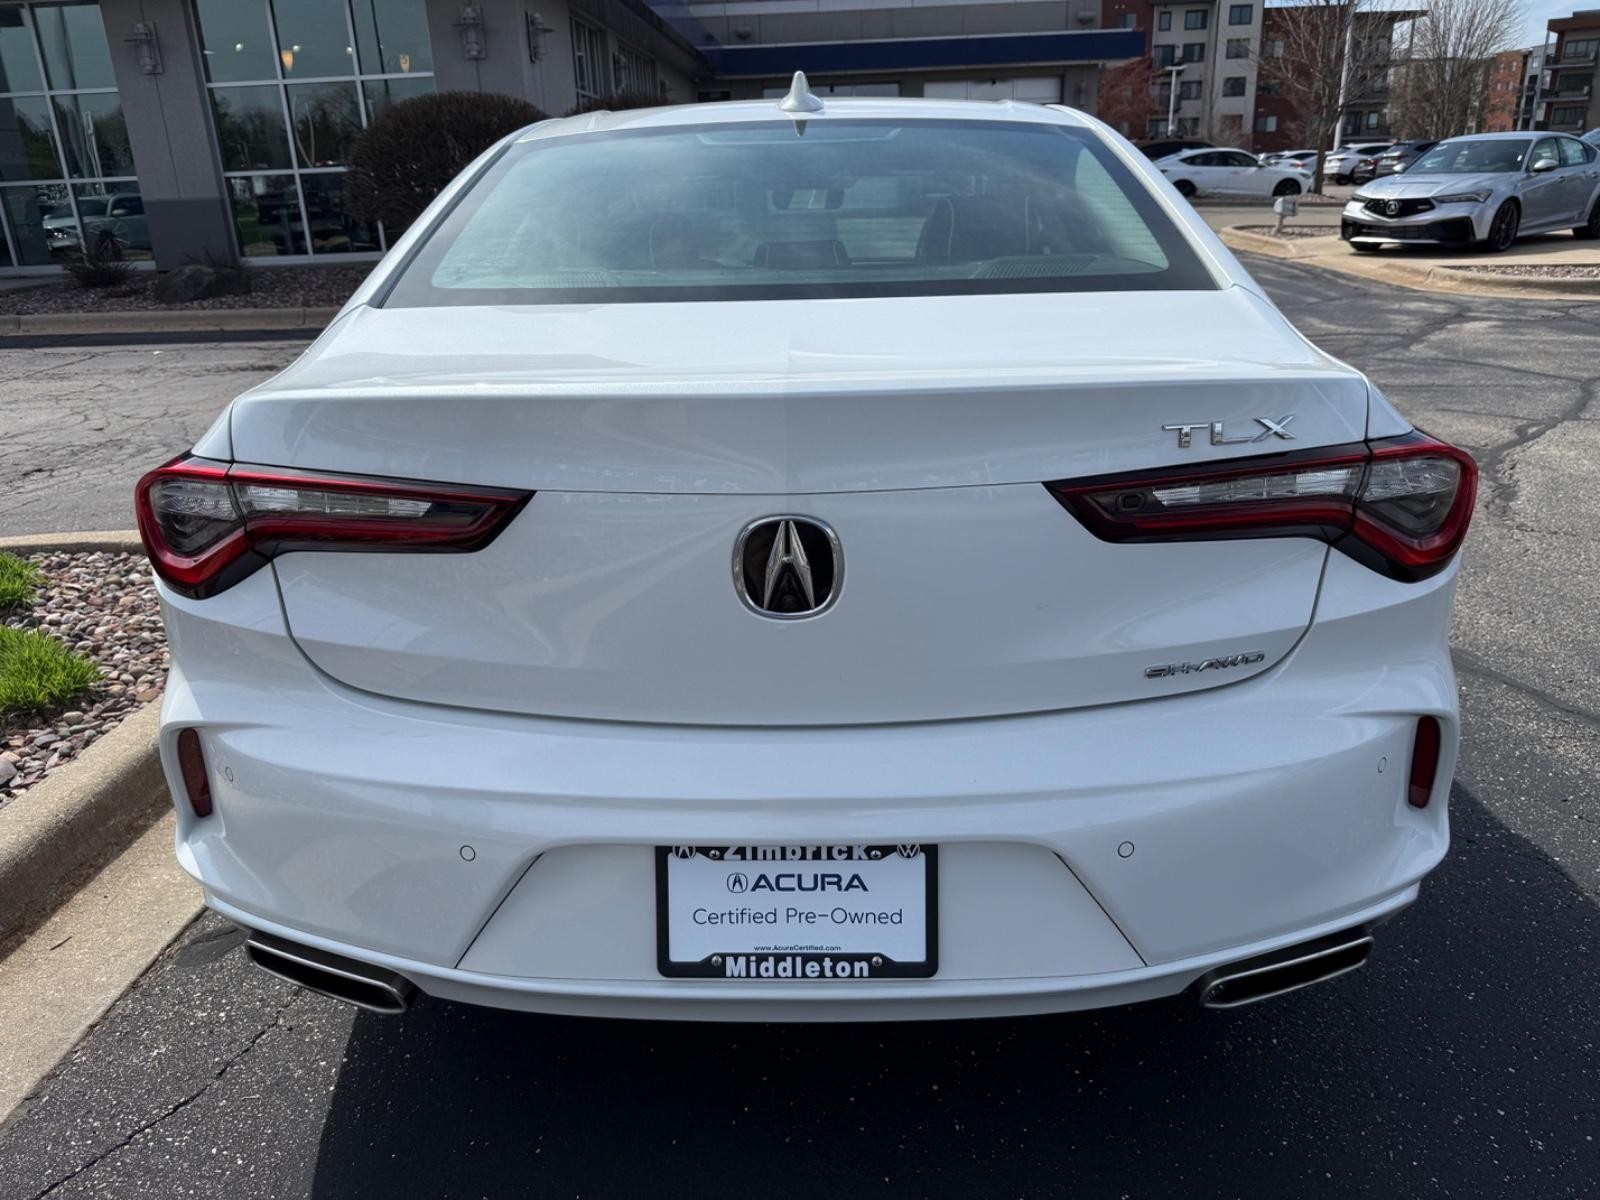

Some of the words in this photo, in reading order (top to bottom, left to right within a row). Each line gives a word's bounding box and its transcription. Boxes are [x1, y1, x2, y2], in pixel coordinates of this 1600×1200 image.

[1162, 415, 1296, 448] TLX
[750, 873, 869, 892] ACURA
[692, 907, 777, 925] Certified
[785, 907, 903, 925] Pre-Owned
[753, 944, 842, 952] www.AcuraCertified.com
[725, 956, 869, 978] Middleton
